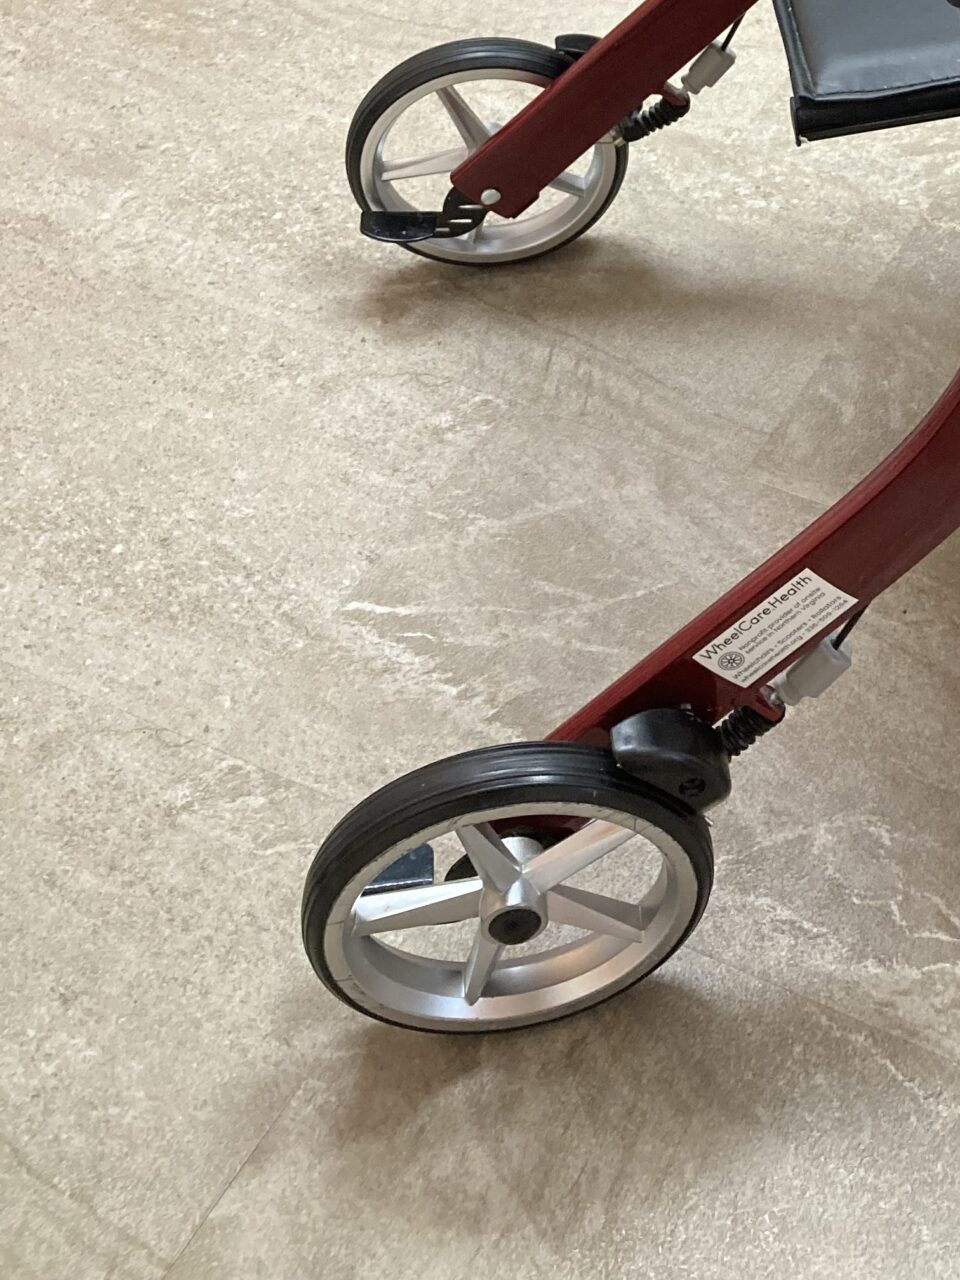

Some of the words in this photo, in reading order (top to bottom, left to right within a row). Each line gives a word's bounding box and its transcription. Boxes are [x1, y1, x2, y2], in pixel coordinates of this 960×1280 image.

[732, 647, 775, 679] Wheelchairs
[777, 622, 808, 645] Scooters
[810, 595, 842, 618] Rollators
[738, 627, 770, 651] Nonprofit
[766, 608, 795, 629] provider
[792, 600, 802, 609] of
[800, 586, 822, 603] onsite
[773, 609, 802, 632] Northern
[800, 591, 827, 612] Virginia
